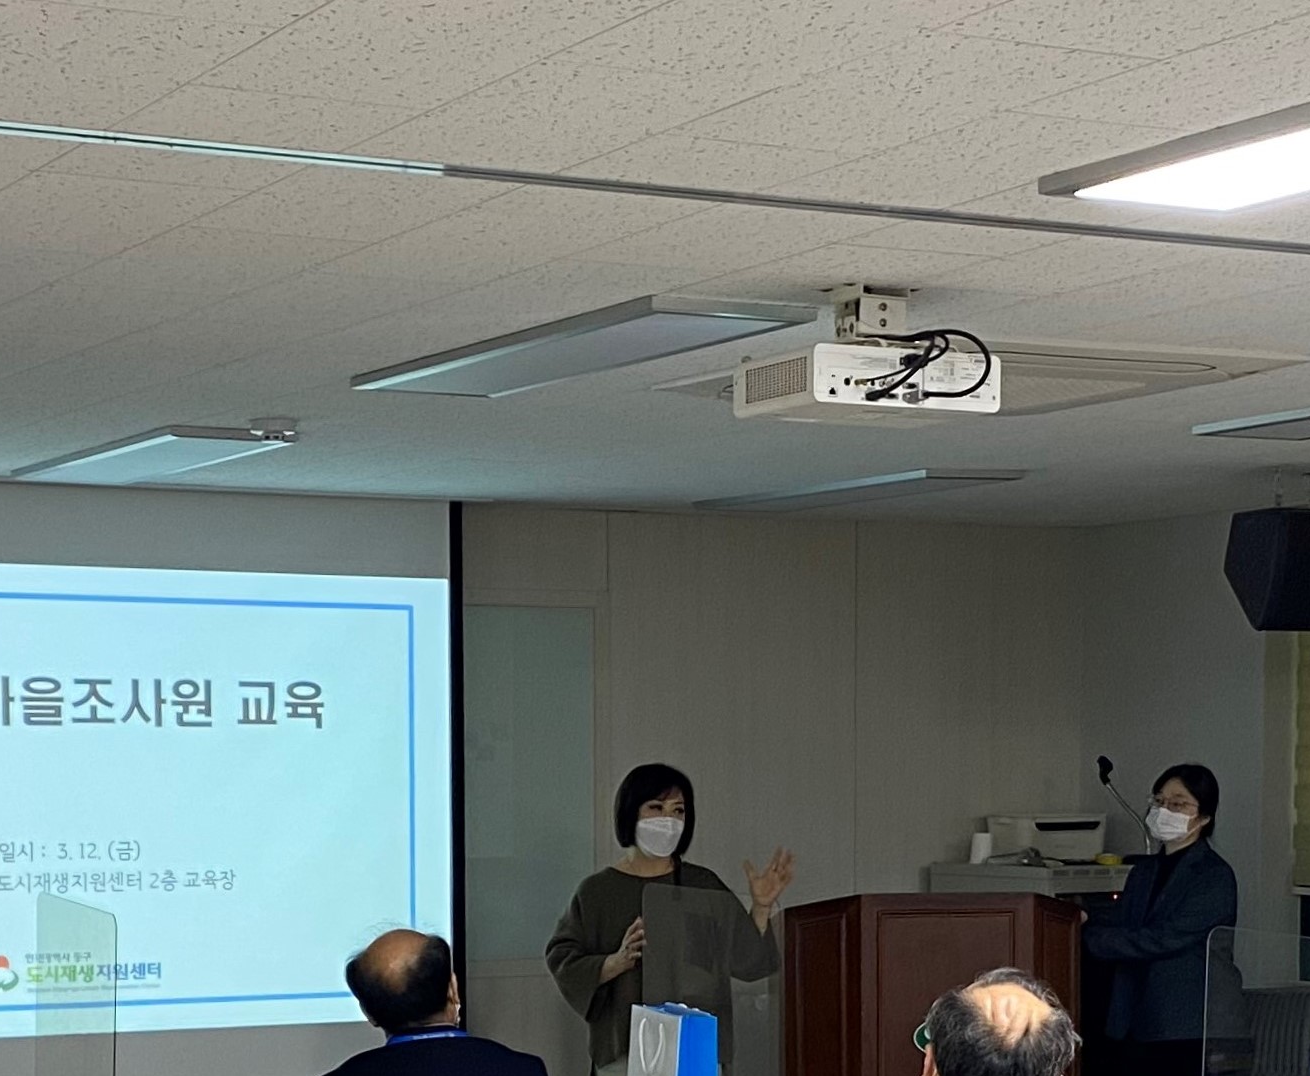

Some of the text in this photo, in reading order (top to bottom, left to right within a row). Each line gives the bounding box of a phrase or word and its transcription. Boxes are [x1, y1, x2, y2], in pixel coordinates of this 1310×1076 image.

[237, 679, 325, 729] 교육
[108, 840, 141, 861] (금)
[149, 869, 178, 892] 2층
[184, 869, 237, 891] 교육장
[26, 962, 162, 983] 도시재생지원센터
